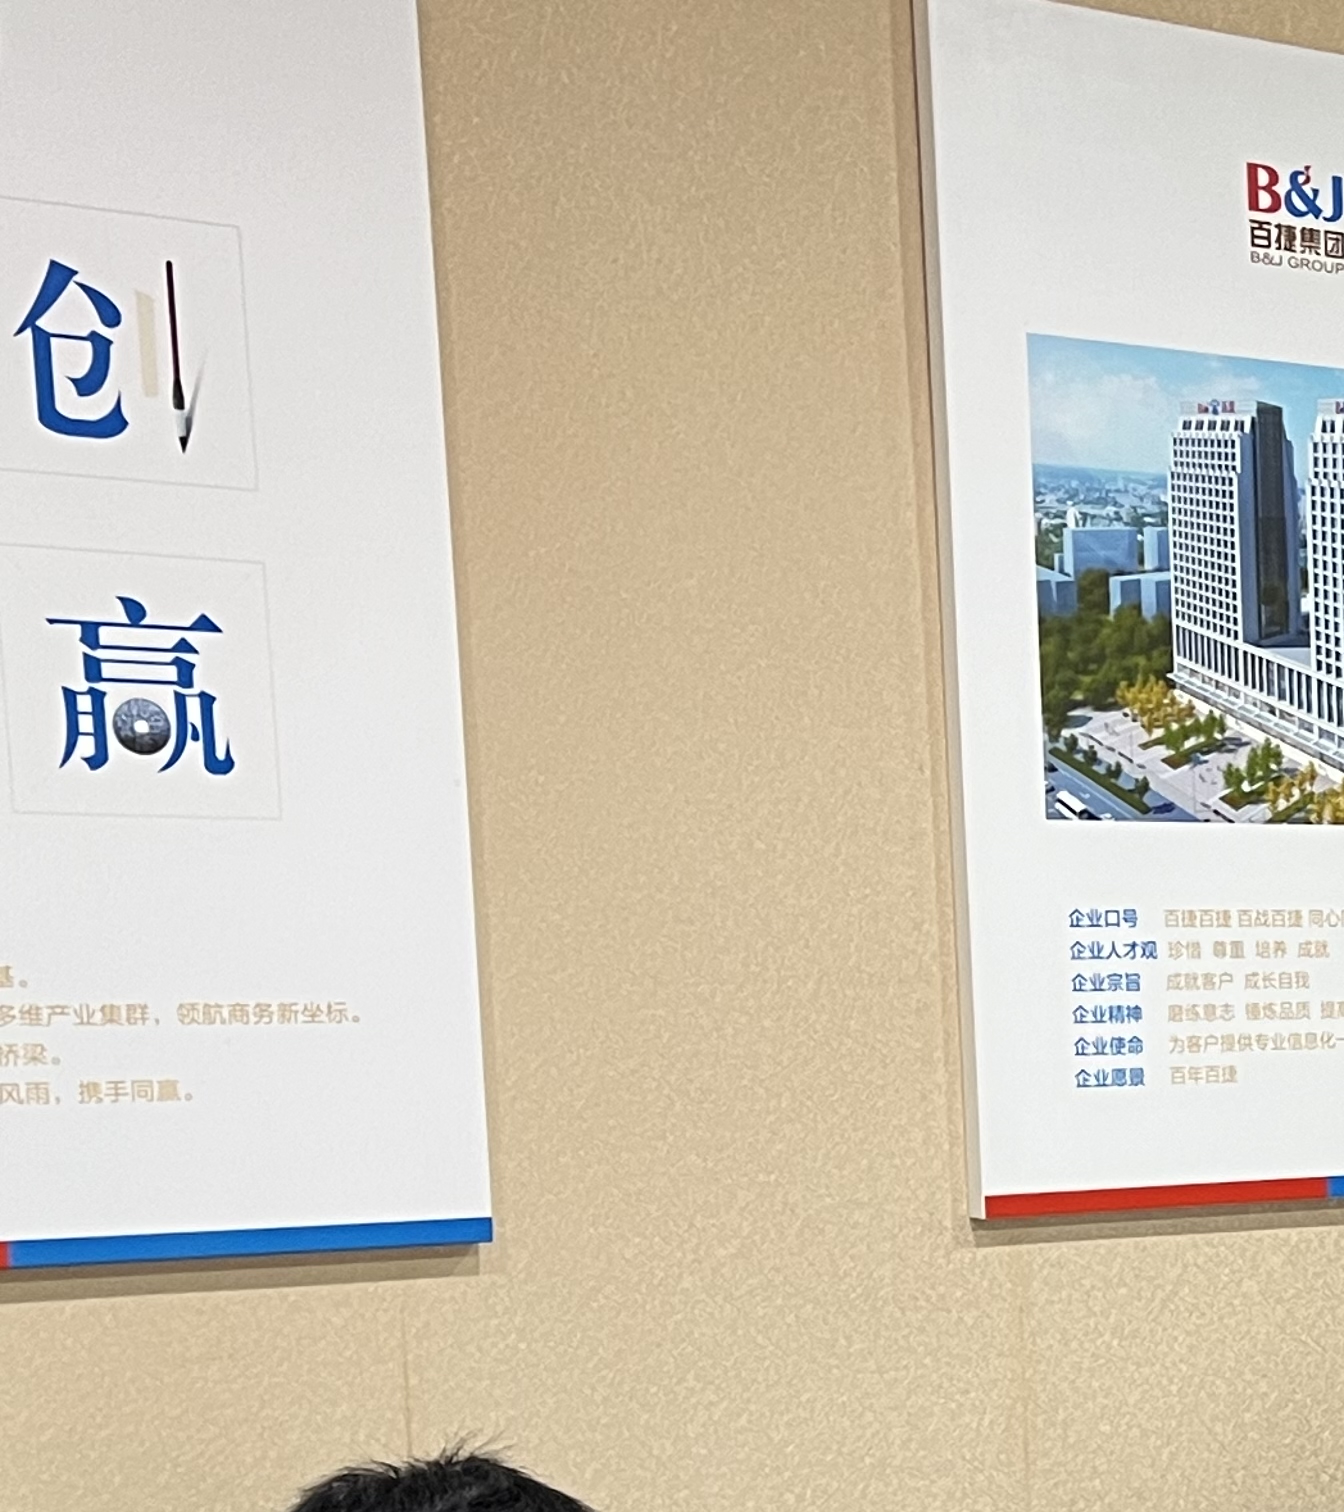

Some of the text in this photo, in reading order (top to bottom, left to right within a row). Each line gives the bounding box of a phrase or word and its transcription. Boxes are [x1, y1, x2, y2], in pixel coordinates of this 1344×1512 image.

[1246, 162, 1344, 222] B&J
[1250, 250, 1283, 266] B&J
[1068, 908, 1139, 928] 企业口号
[1164, 909, 1232, 928] 百捷百捷
[1237, 909, 1303, 928] 百战百捷
[1069, 940, 1331, 960] 企业人才观 珍惜 尊重 培养 成就
[1071, 970, 1311, 992] 企业宗旨 成就客户 成长自我
[1072, 1004, 1143, 1024] 企业精神
[1073, 1035, 1144, 1056] 企业使命
[1074, 1064, 1238, 1088] 企业愿景 百年百捷
